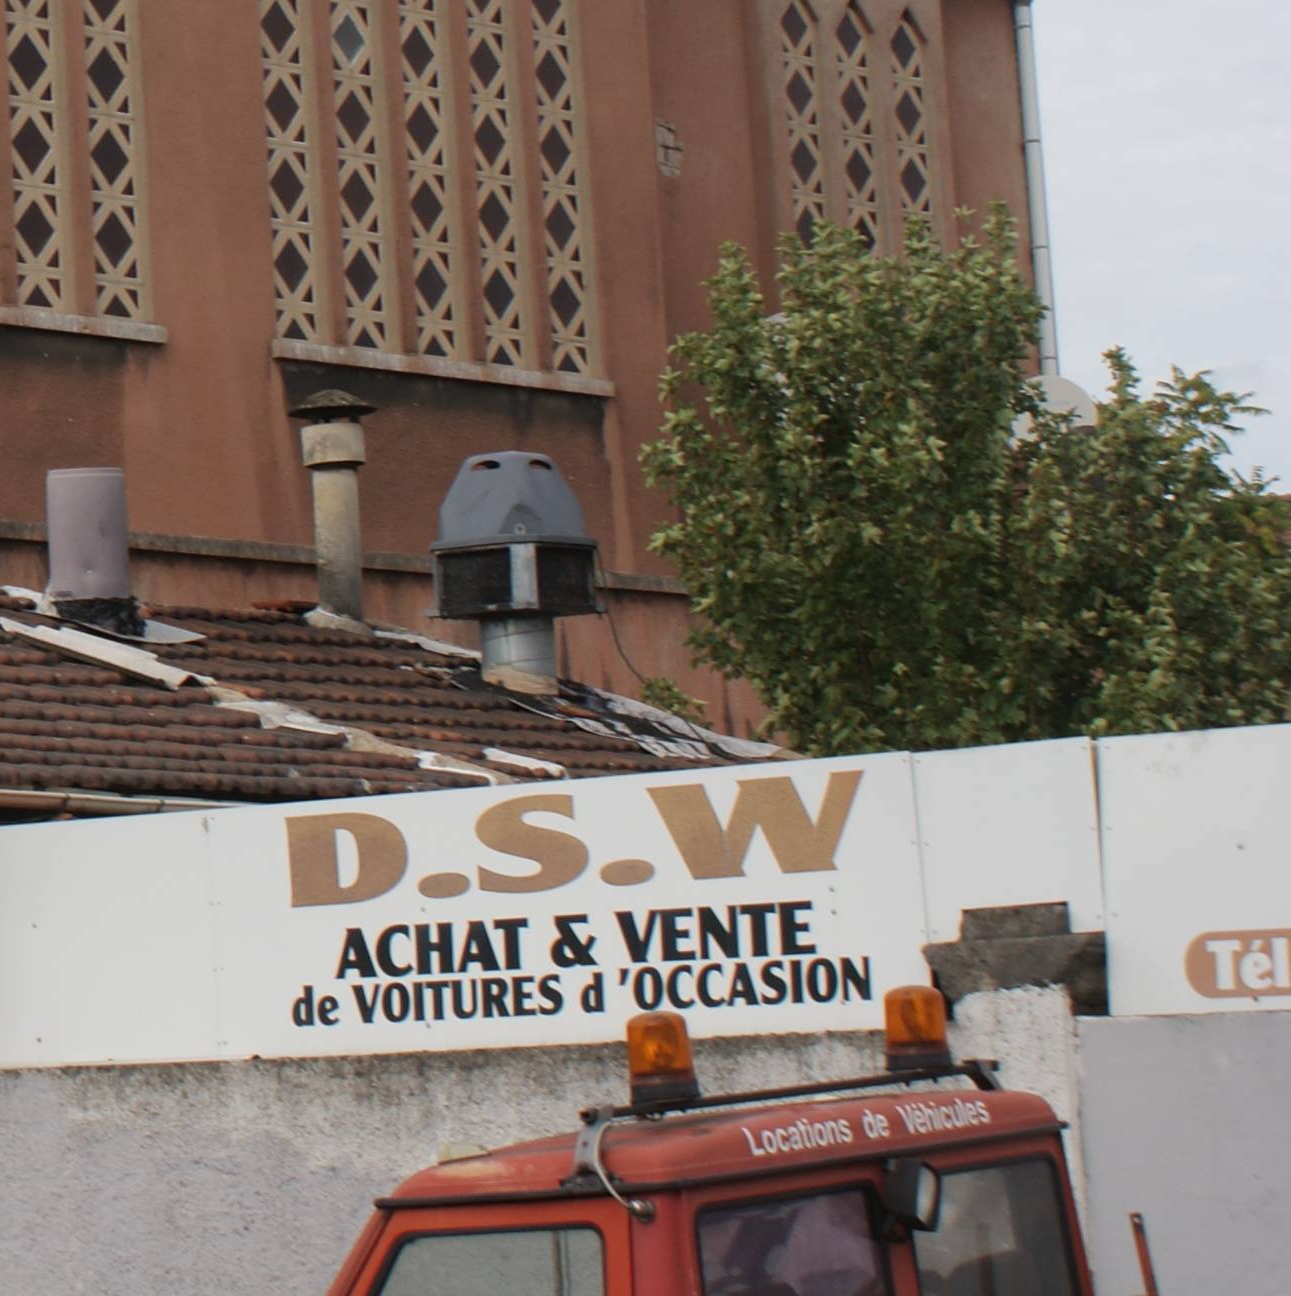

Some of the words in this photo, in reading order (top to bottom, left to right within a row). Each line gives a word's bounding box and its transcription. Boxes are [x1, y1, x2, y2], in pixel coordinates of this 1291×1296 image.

[284, 770, 864, 907] D.S.W
[336, 917, 529, 979] ACHAT
[551, 913, 598, 968] &
[614, 901, 817, 963] VENTE
[292, 985, 340, 1027] de
[351, 973, 564, 1024] VOITURES
[742, 1118, 854, 1156] Locations
[862, 1109, 890, 1138] de
